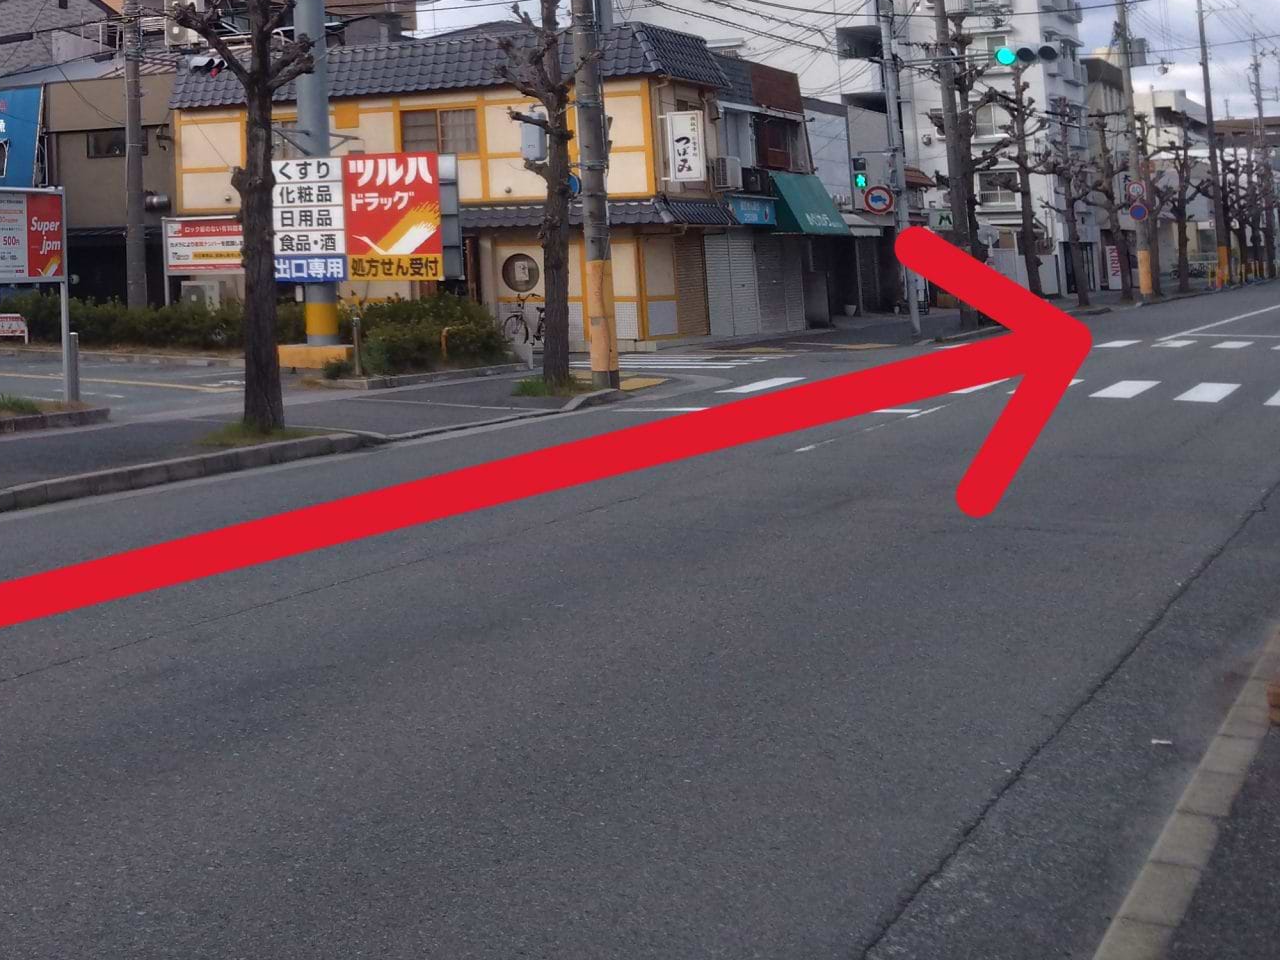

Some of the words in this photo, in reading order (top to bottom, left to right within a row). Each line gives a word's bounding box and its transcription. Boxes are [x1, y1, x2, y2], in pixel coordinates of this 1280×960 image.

[675, 136, 693, 173] つぼみ
[278, 161, 330, 180] くすり
[348, 156, 433, 187] ツルハ
[279, 185, 332, 204] 化粧品
[350, 191, 415, 212] ドラッグ
[31, 216, 60, 235] Super
[280, 209, 332, 228] 日用品
[40, 236, 61, 255] jpm
[279, 234, 336, 252] 食品・酒
[274, 258, 344, 279] 出口専用
[351, 257, 439, 278] 処方せん受付
[1108, 247, 1121, 277] KIRIN
